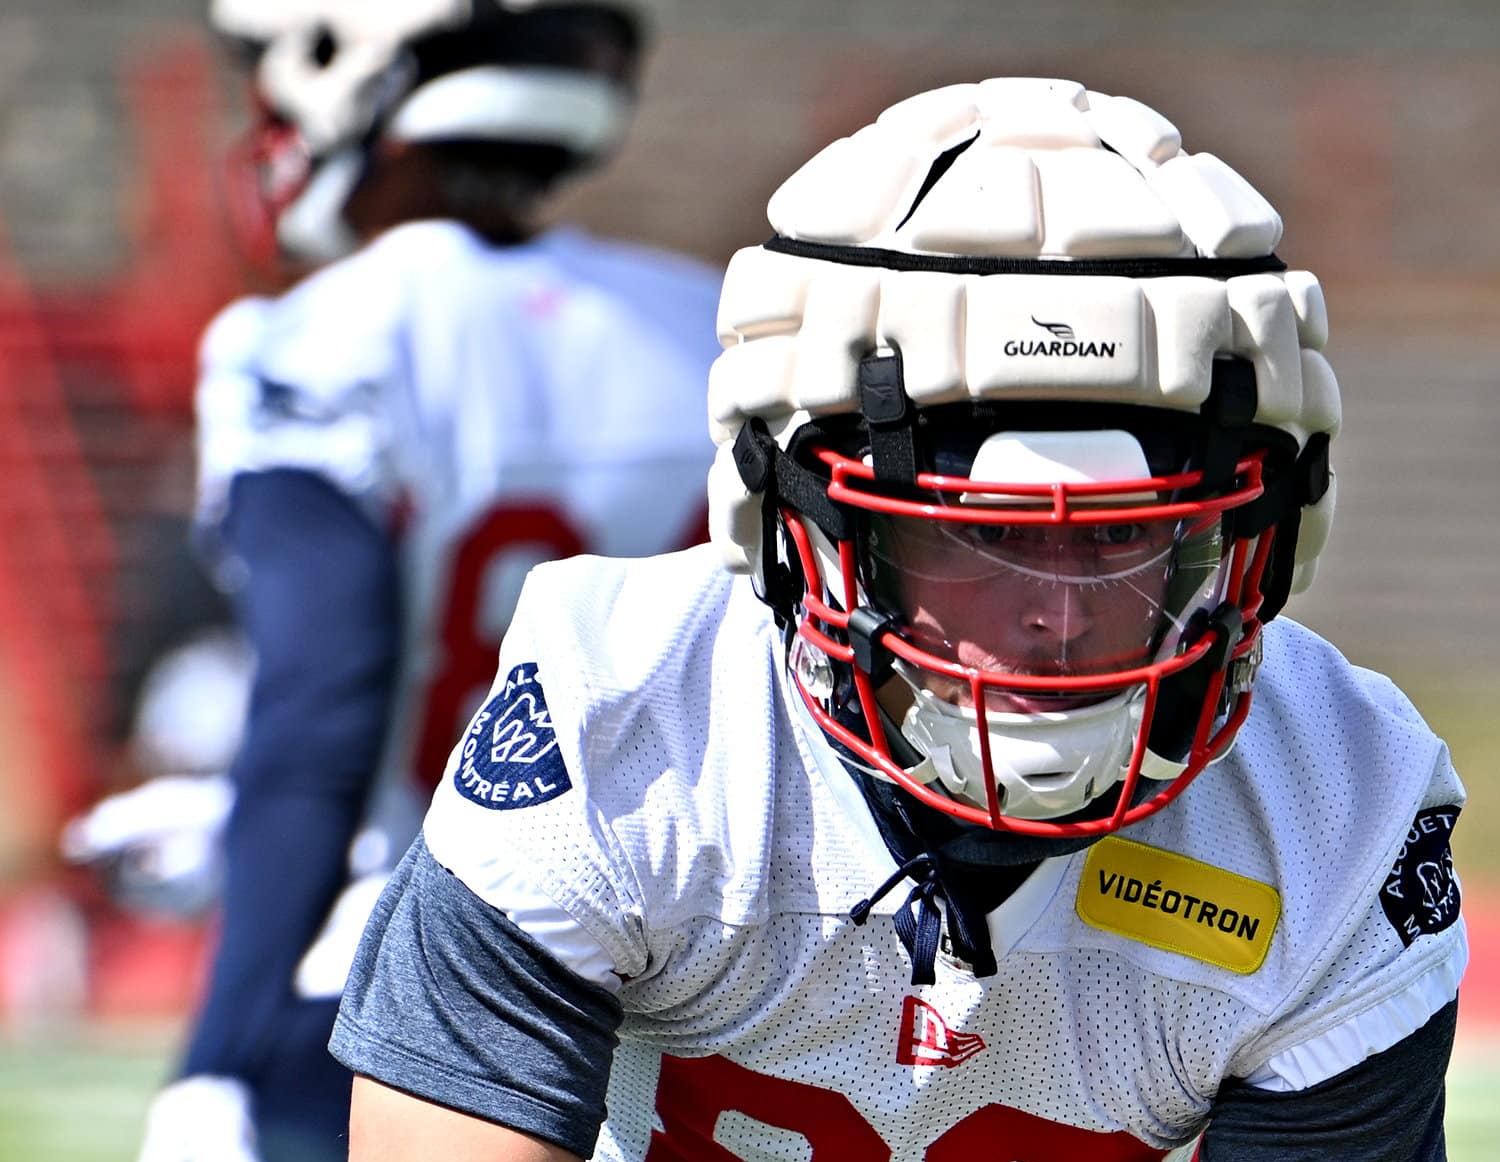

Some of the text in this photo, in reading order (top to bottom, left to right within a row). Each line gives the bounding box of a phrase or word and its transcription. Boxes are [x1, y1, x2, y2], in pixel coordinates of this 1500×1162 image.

[1004, 340, 1116, 358] GUARDIAN
[461, 711, 557, 802] MONTRÉAL
[1099, 869, 1260, 941] VIDÉOTRON
